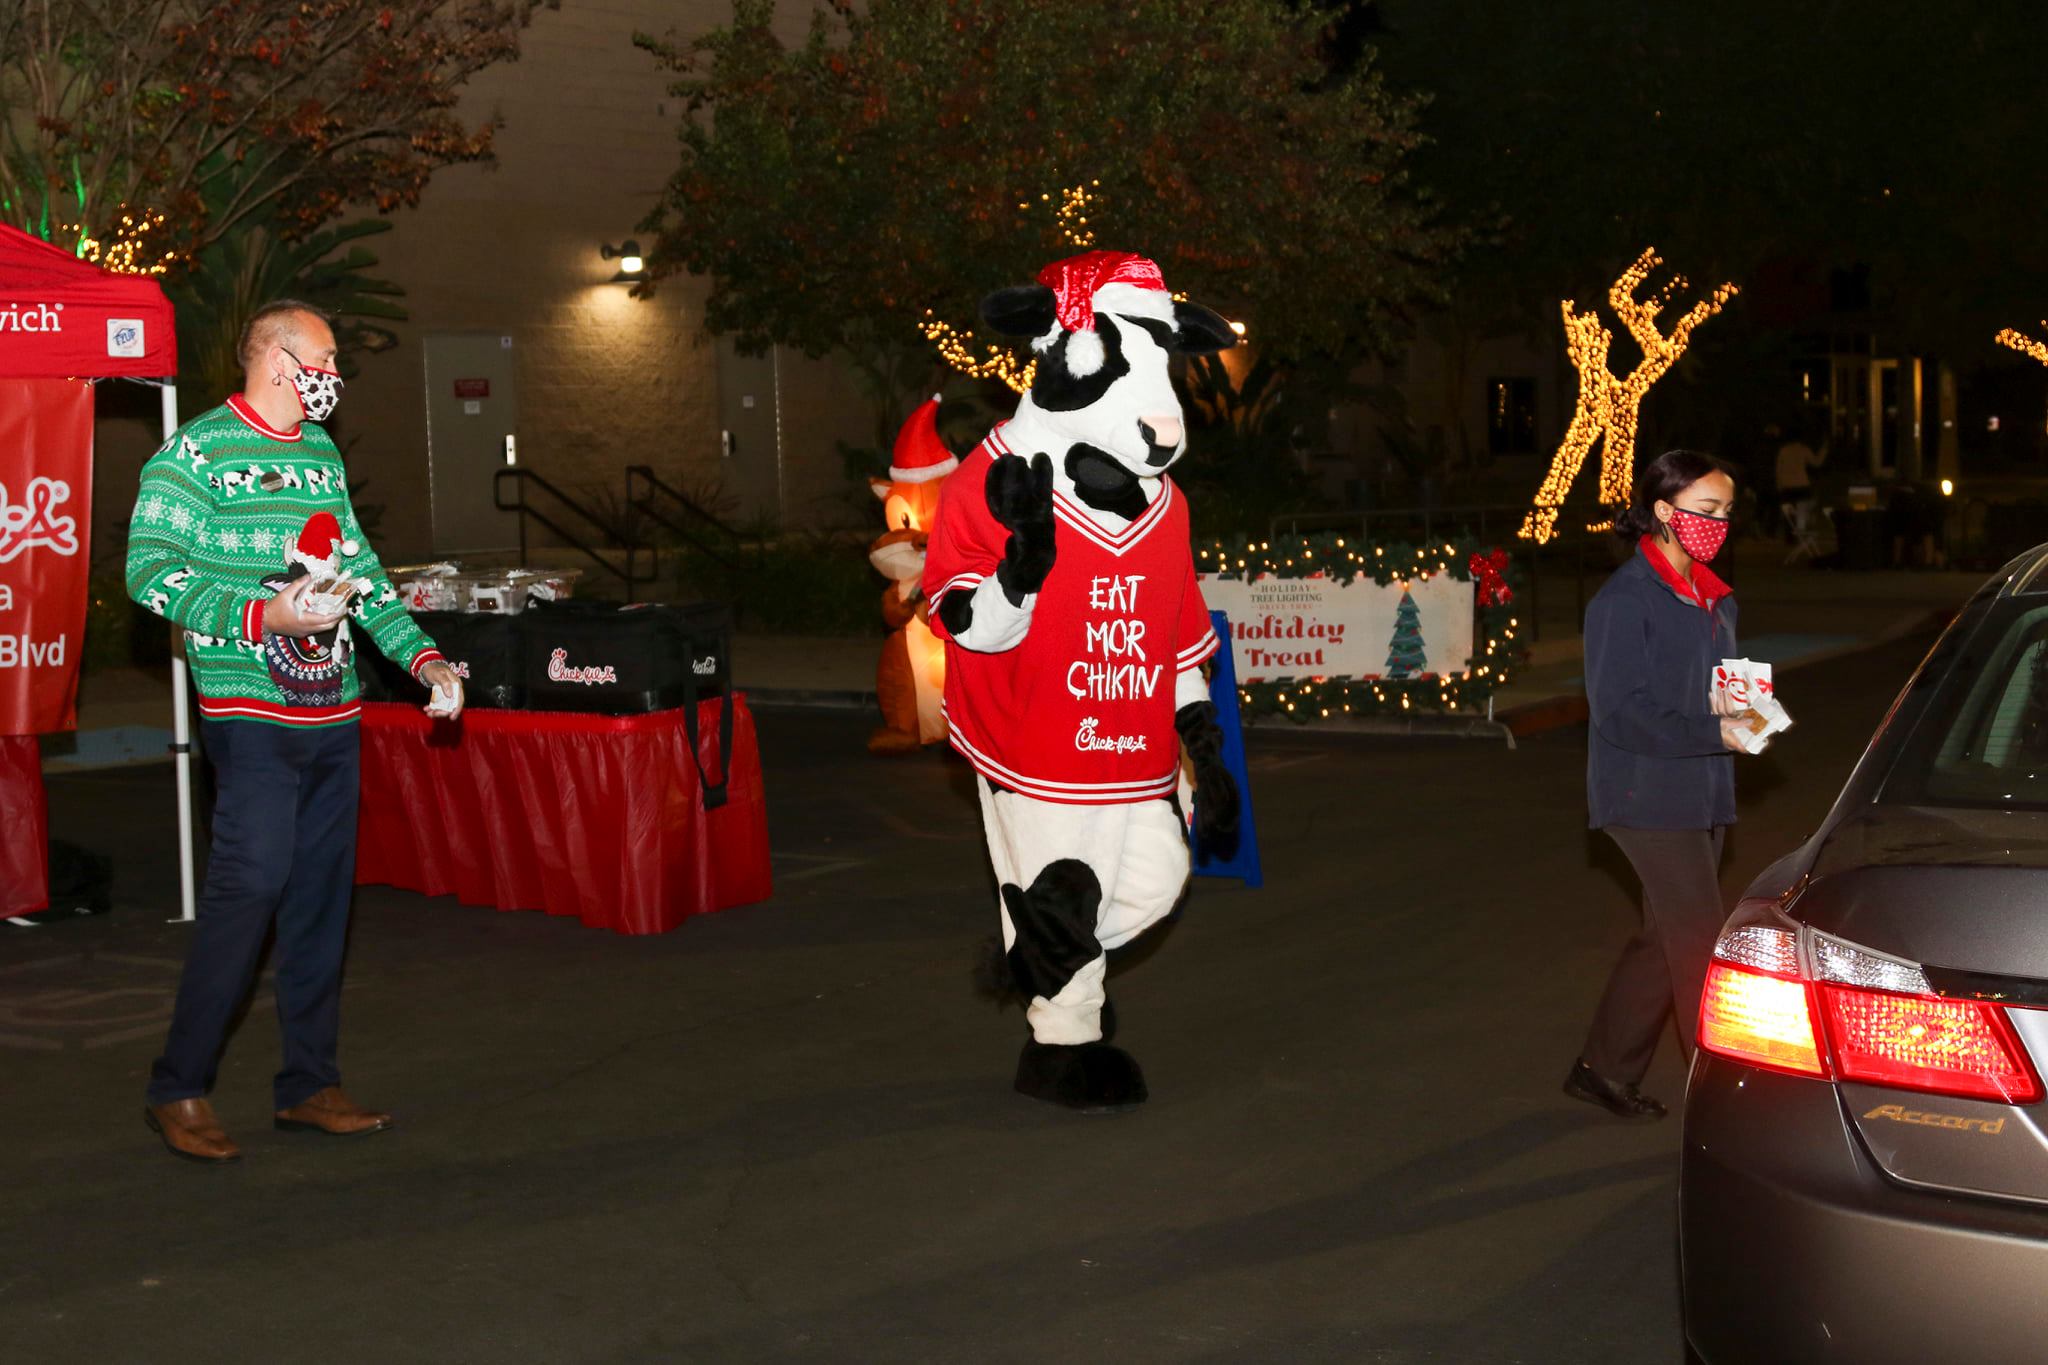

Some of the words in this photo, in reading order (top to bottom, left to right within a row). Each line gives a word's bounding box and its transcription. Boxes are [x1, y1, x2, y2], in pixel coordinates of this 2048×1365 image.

[1089, 574, 1146, 613] EAT
[1251, 594, 1275, 603] TREE
[1277, 593, 1323, 603] LIGHTING
[1261, 584, 1311, 593] HOLIDAY
[1086, 619, 1146, 662] MOR
[1228, 614, 1345, 644] Holiday
[0, 633, 66, 668] Blvd
[1244, 648, 1325, 668] Treat
[1067, 661, 1160, 701] CHIKIN
[1075, 717, 1146, 754] Chick-fil-A
[1863, 1104, 2005, 1134] Accord
